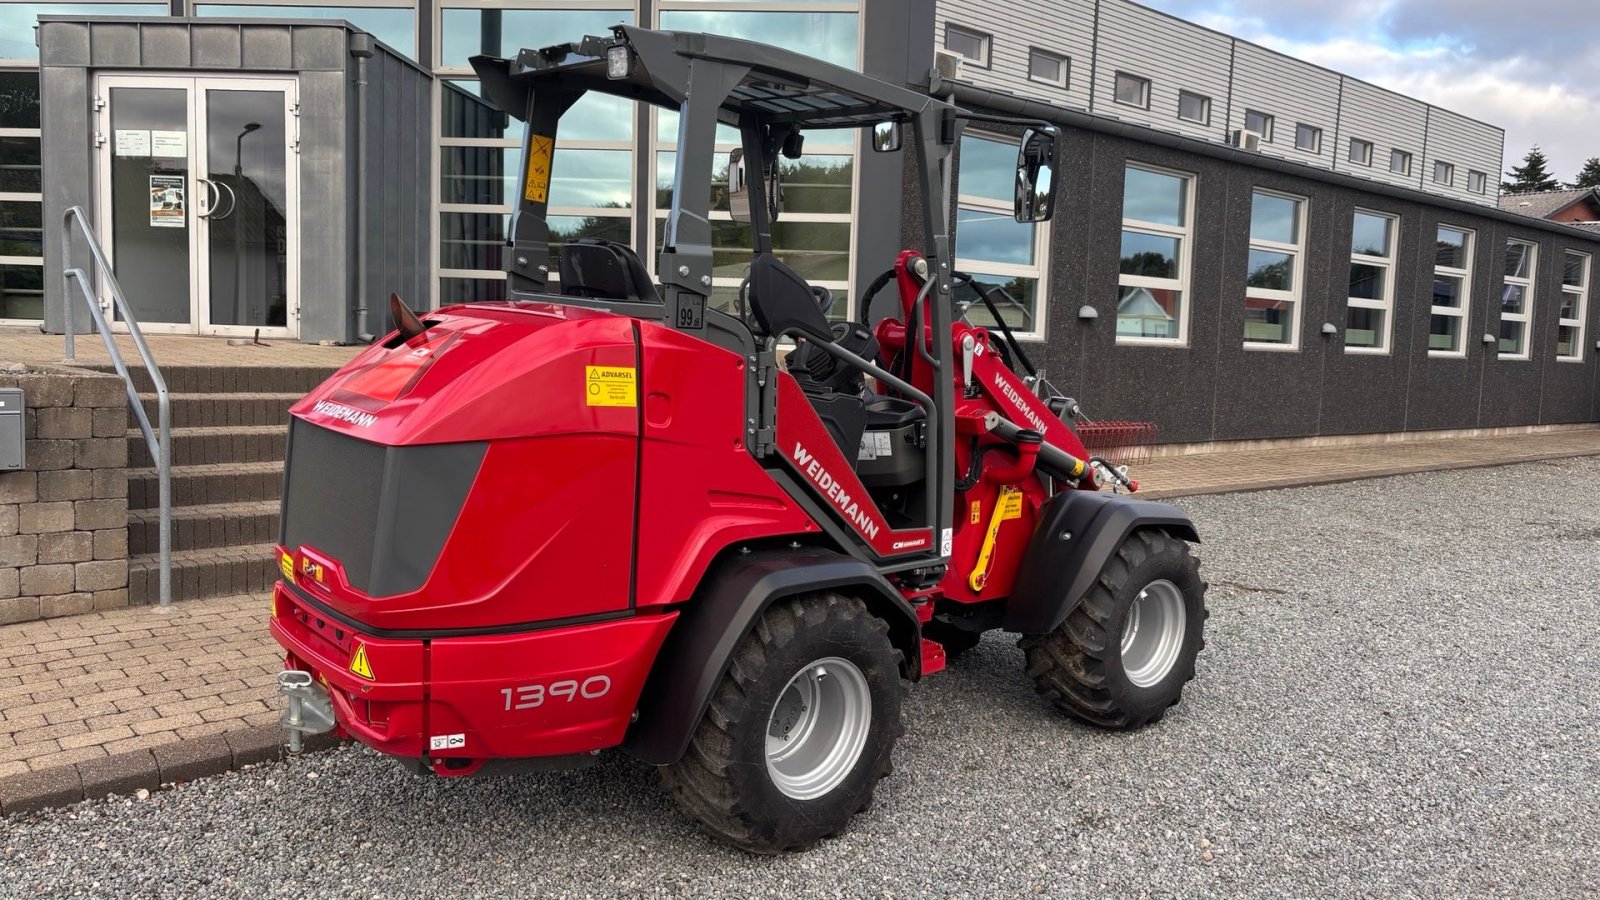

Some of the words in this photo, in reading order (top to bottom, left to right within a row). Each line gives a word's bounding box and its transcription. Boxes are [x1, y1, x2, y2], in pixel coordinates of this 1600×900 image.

[680, 308, 693, 326] 99
[601, 371, 632, 379] ADVARSEL
[312, 400, 378, 428] WEIDEMANN
[994, 372, 1048, 435] WEIDEMANN
[793, 441, 880, 541] WEIDEMANN
[500, 674, 611, 711] 1390
